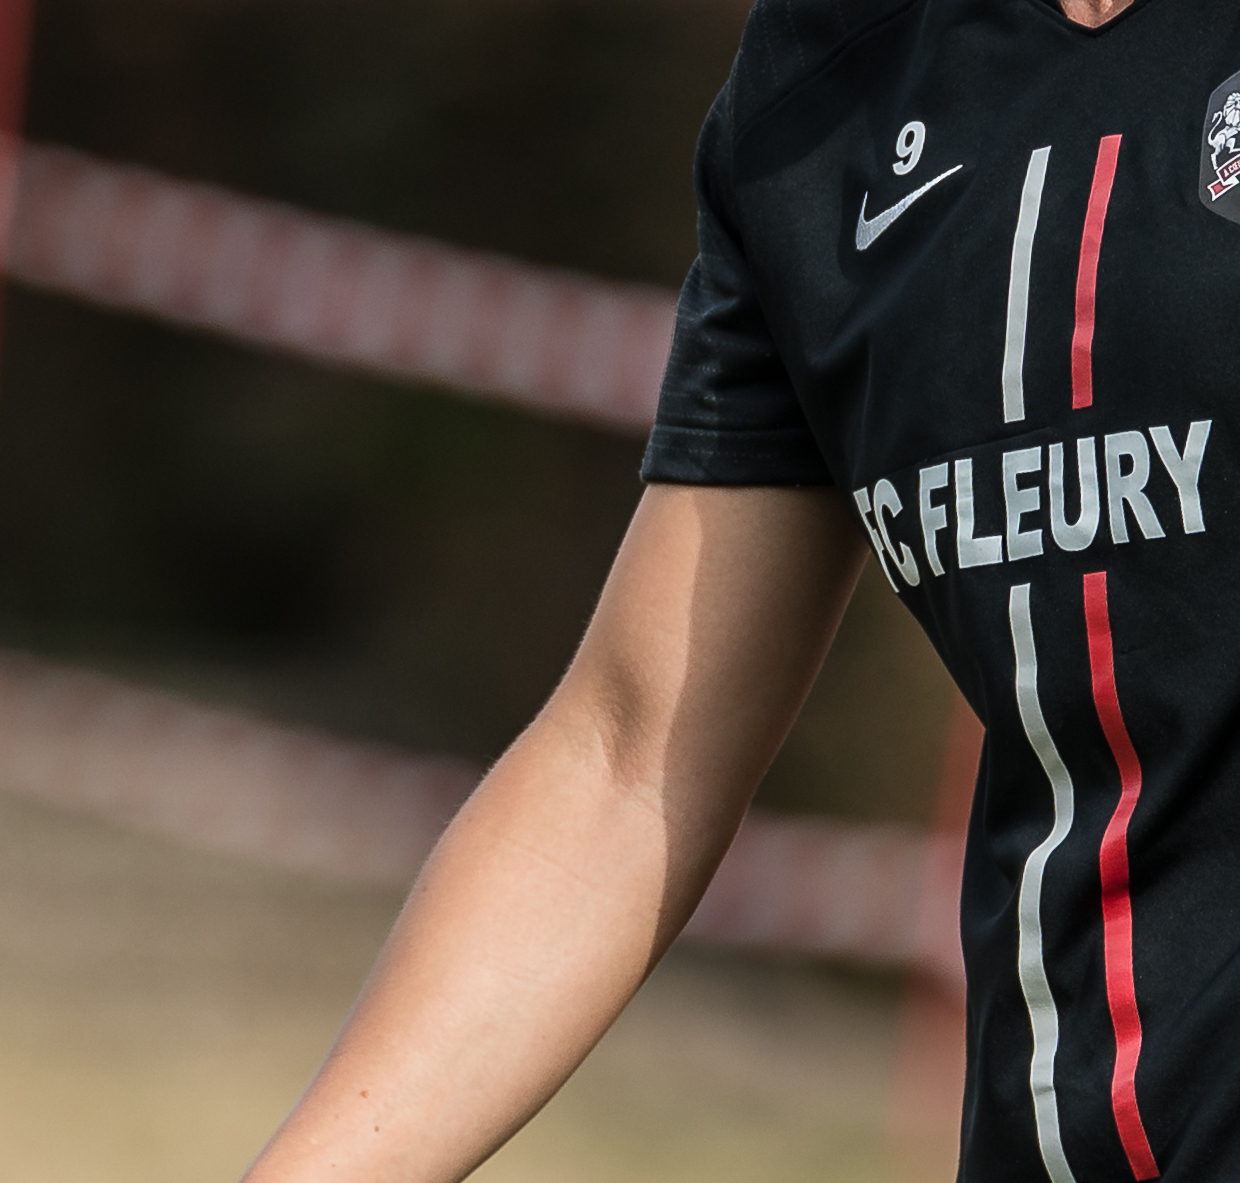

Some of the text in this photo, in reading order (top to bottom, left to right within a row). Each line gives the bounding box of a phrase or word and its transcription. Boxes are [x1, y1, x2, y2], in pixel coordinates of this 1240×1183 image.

[892, 120, 927, 176] 9
[852, 478, 920, 593] FC
[918, 419, 1213, 579] FLEURY
